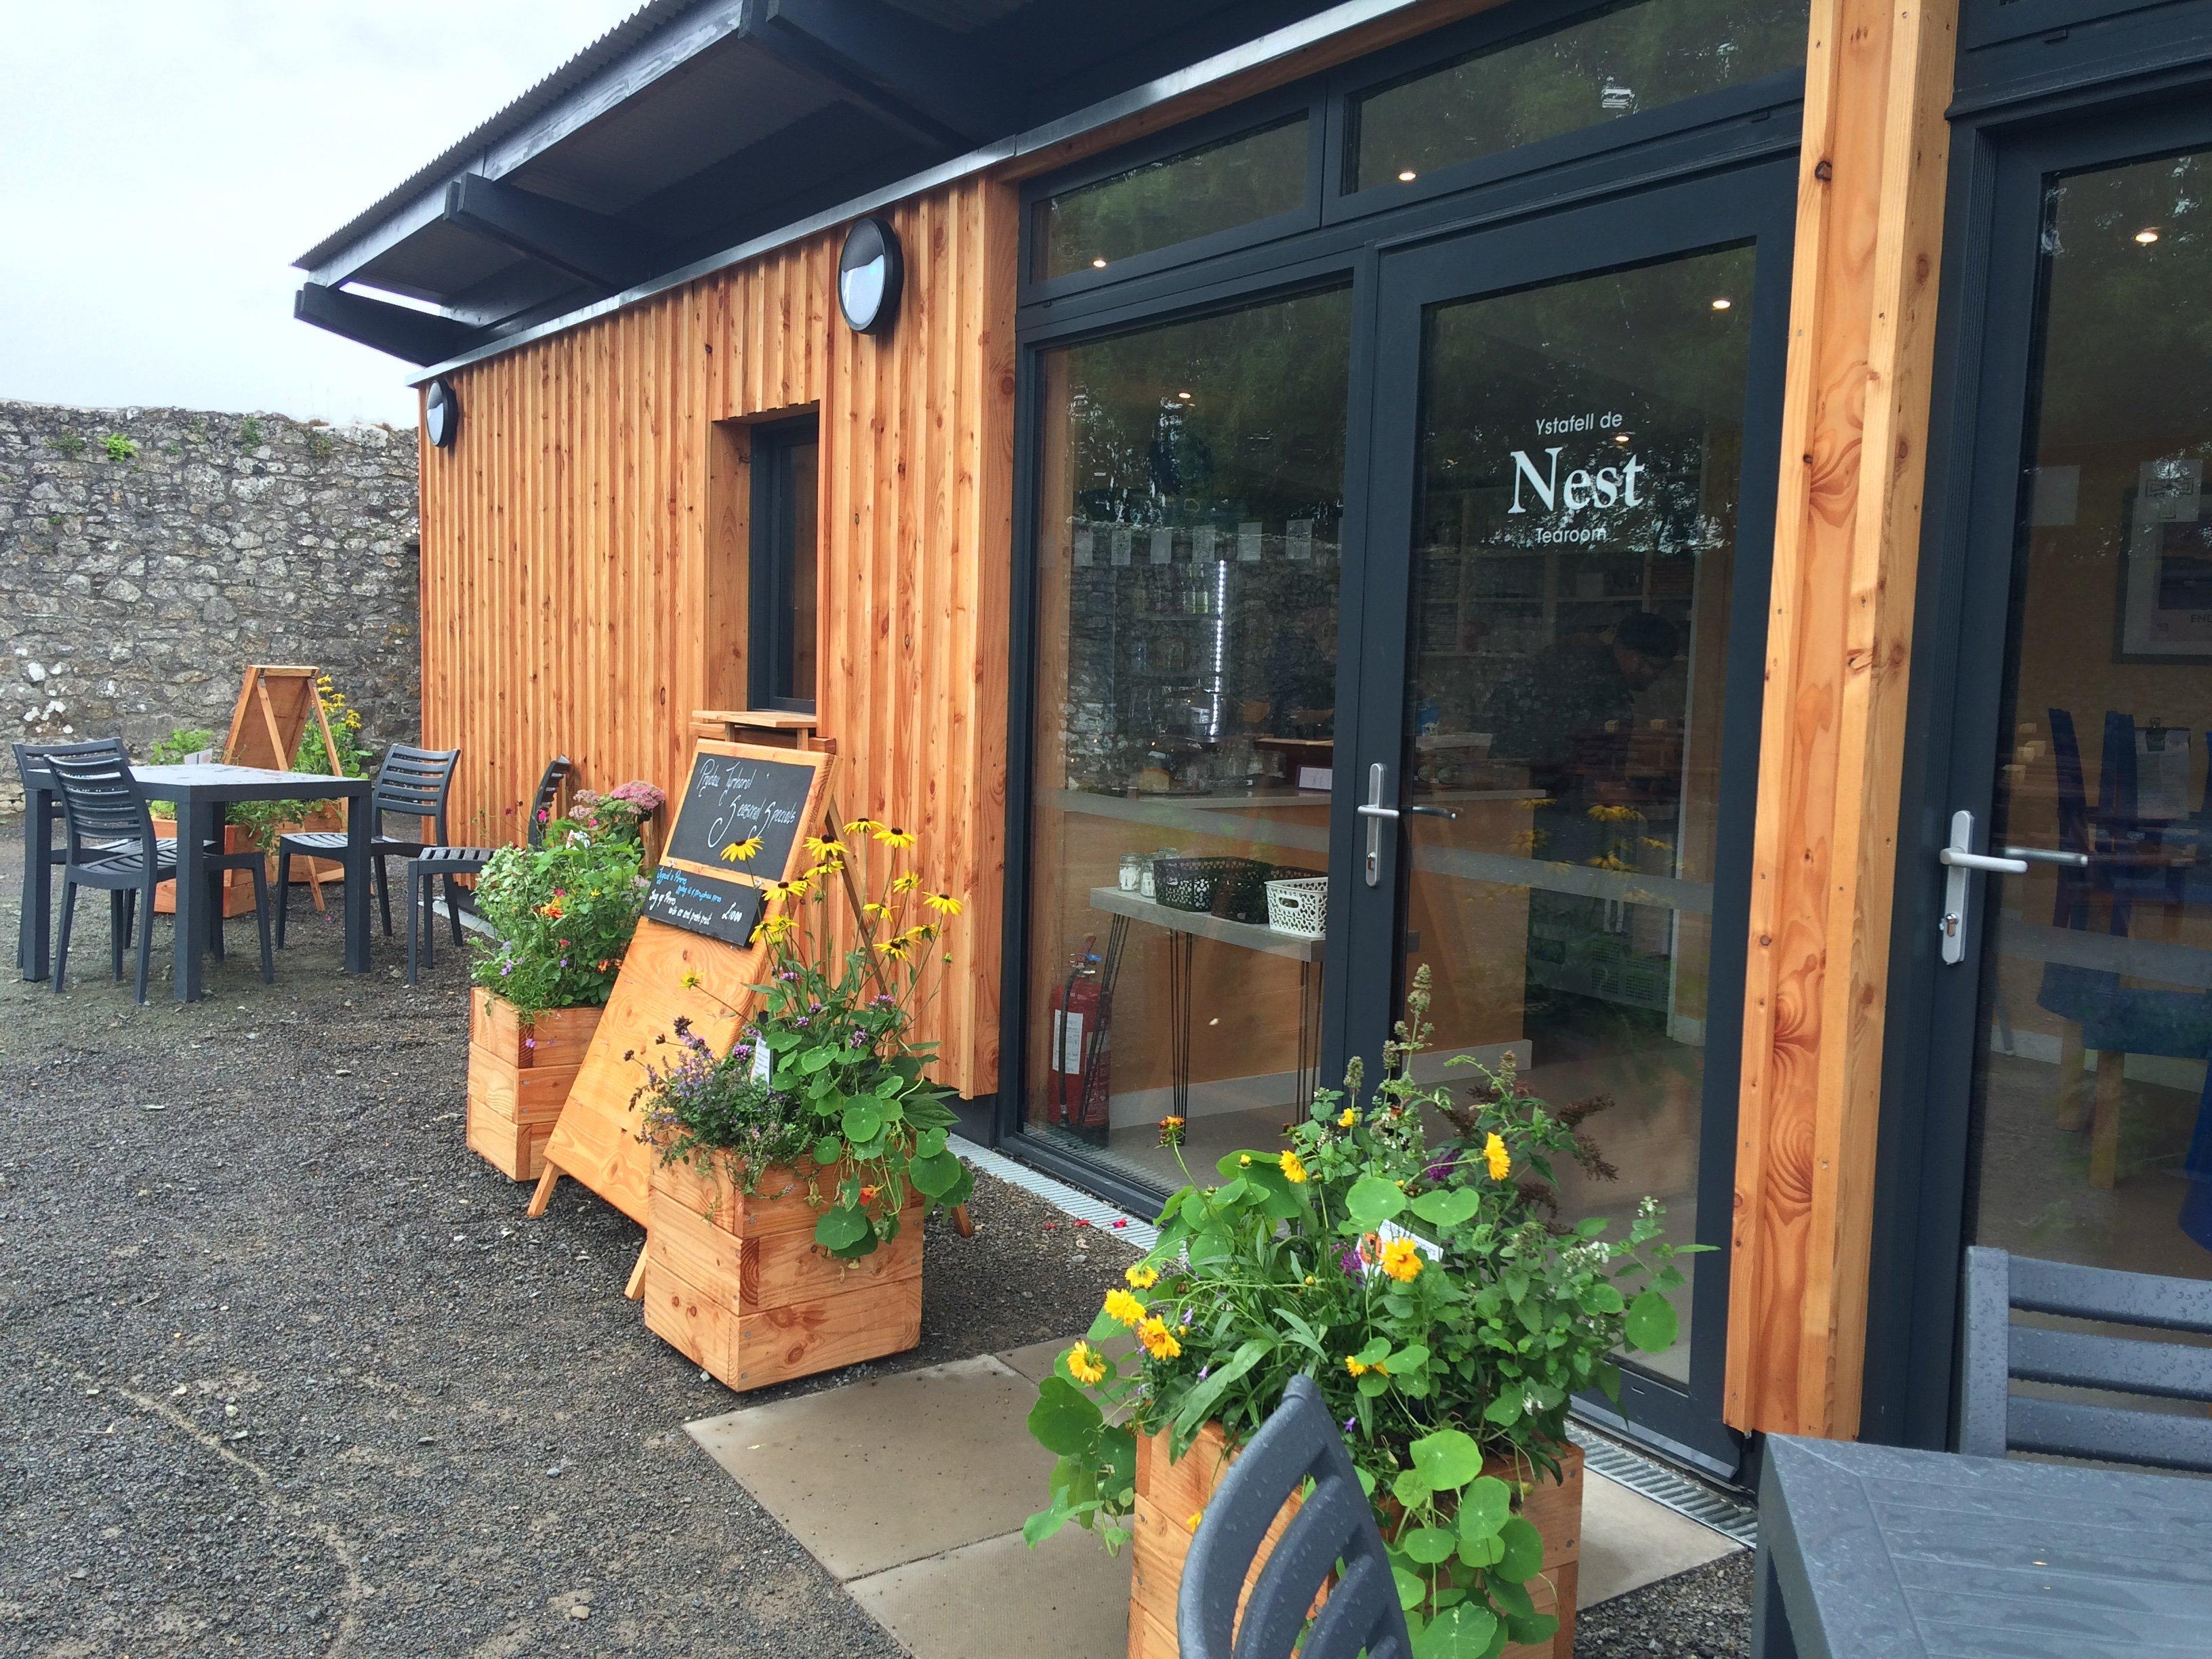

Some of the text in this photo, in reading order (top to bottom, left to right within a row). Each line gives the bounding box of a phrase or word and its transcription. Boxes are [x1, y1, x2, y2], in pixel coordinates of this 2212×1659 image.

[1536, 411, 1622, 436] Ystafell de
[1507, 447, 1645, 514] Nest
[1534, 527, 1607, 544] Tearoom
[708, 794, 797, 848] Seasonal Specials
